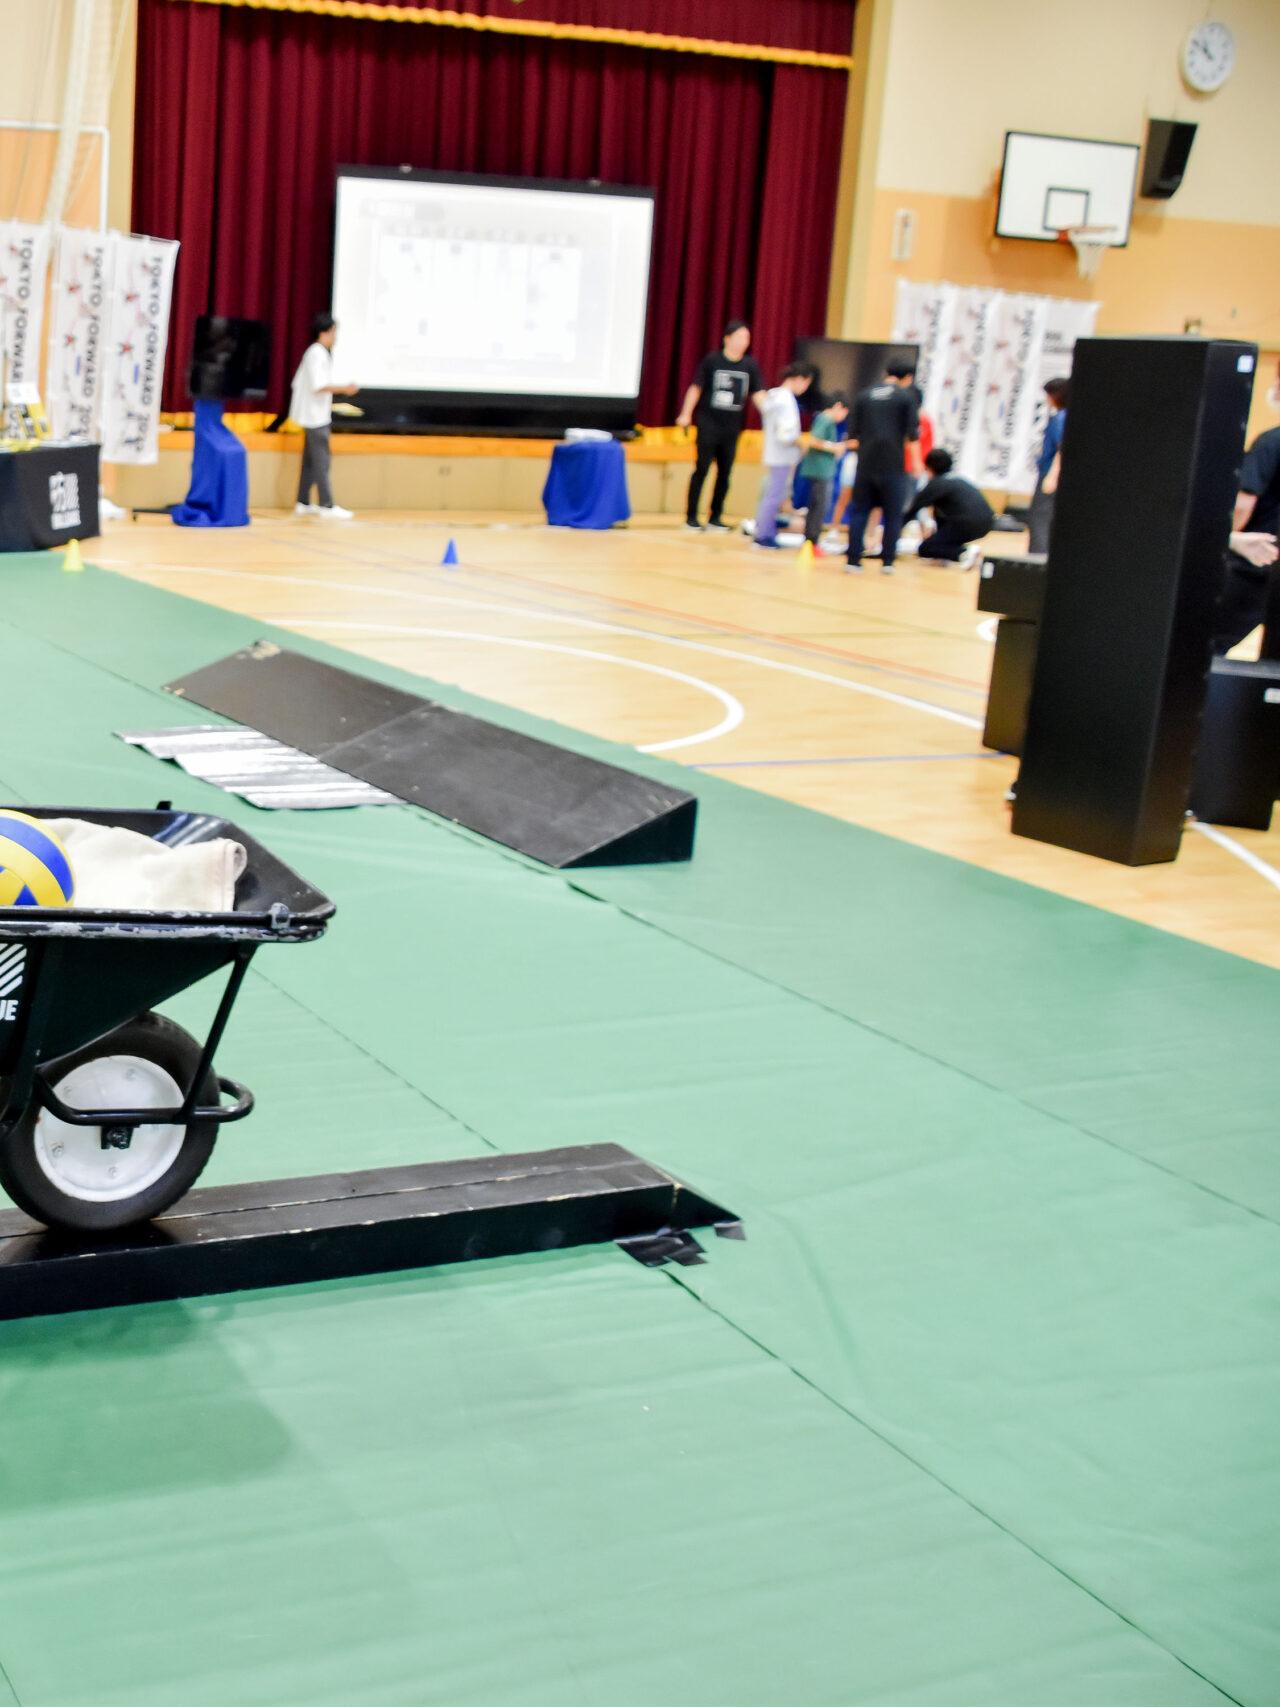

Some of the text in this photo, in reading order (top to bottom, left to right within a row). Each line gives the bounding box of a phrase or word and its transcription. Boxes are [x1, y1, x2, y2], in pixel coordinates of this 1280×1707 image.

[17, 237, 34, 300] TOKYO
[90, 247, 104, 307] TOKYO
[147, 256, 163, 317] TOKYO
[12, 307, 28, 383] FORWAR
[84, 314, 100, 397] FORWARD
[141, 322, 159, 406] FORWARD
